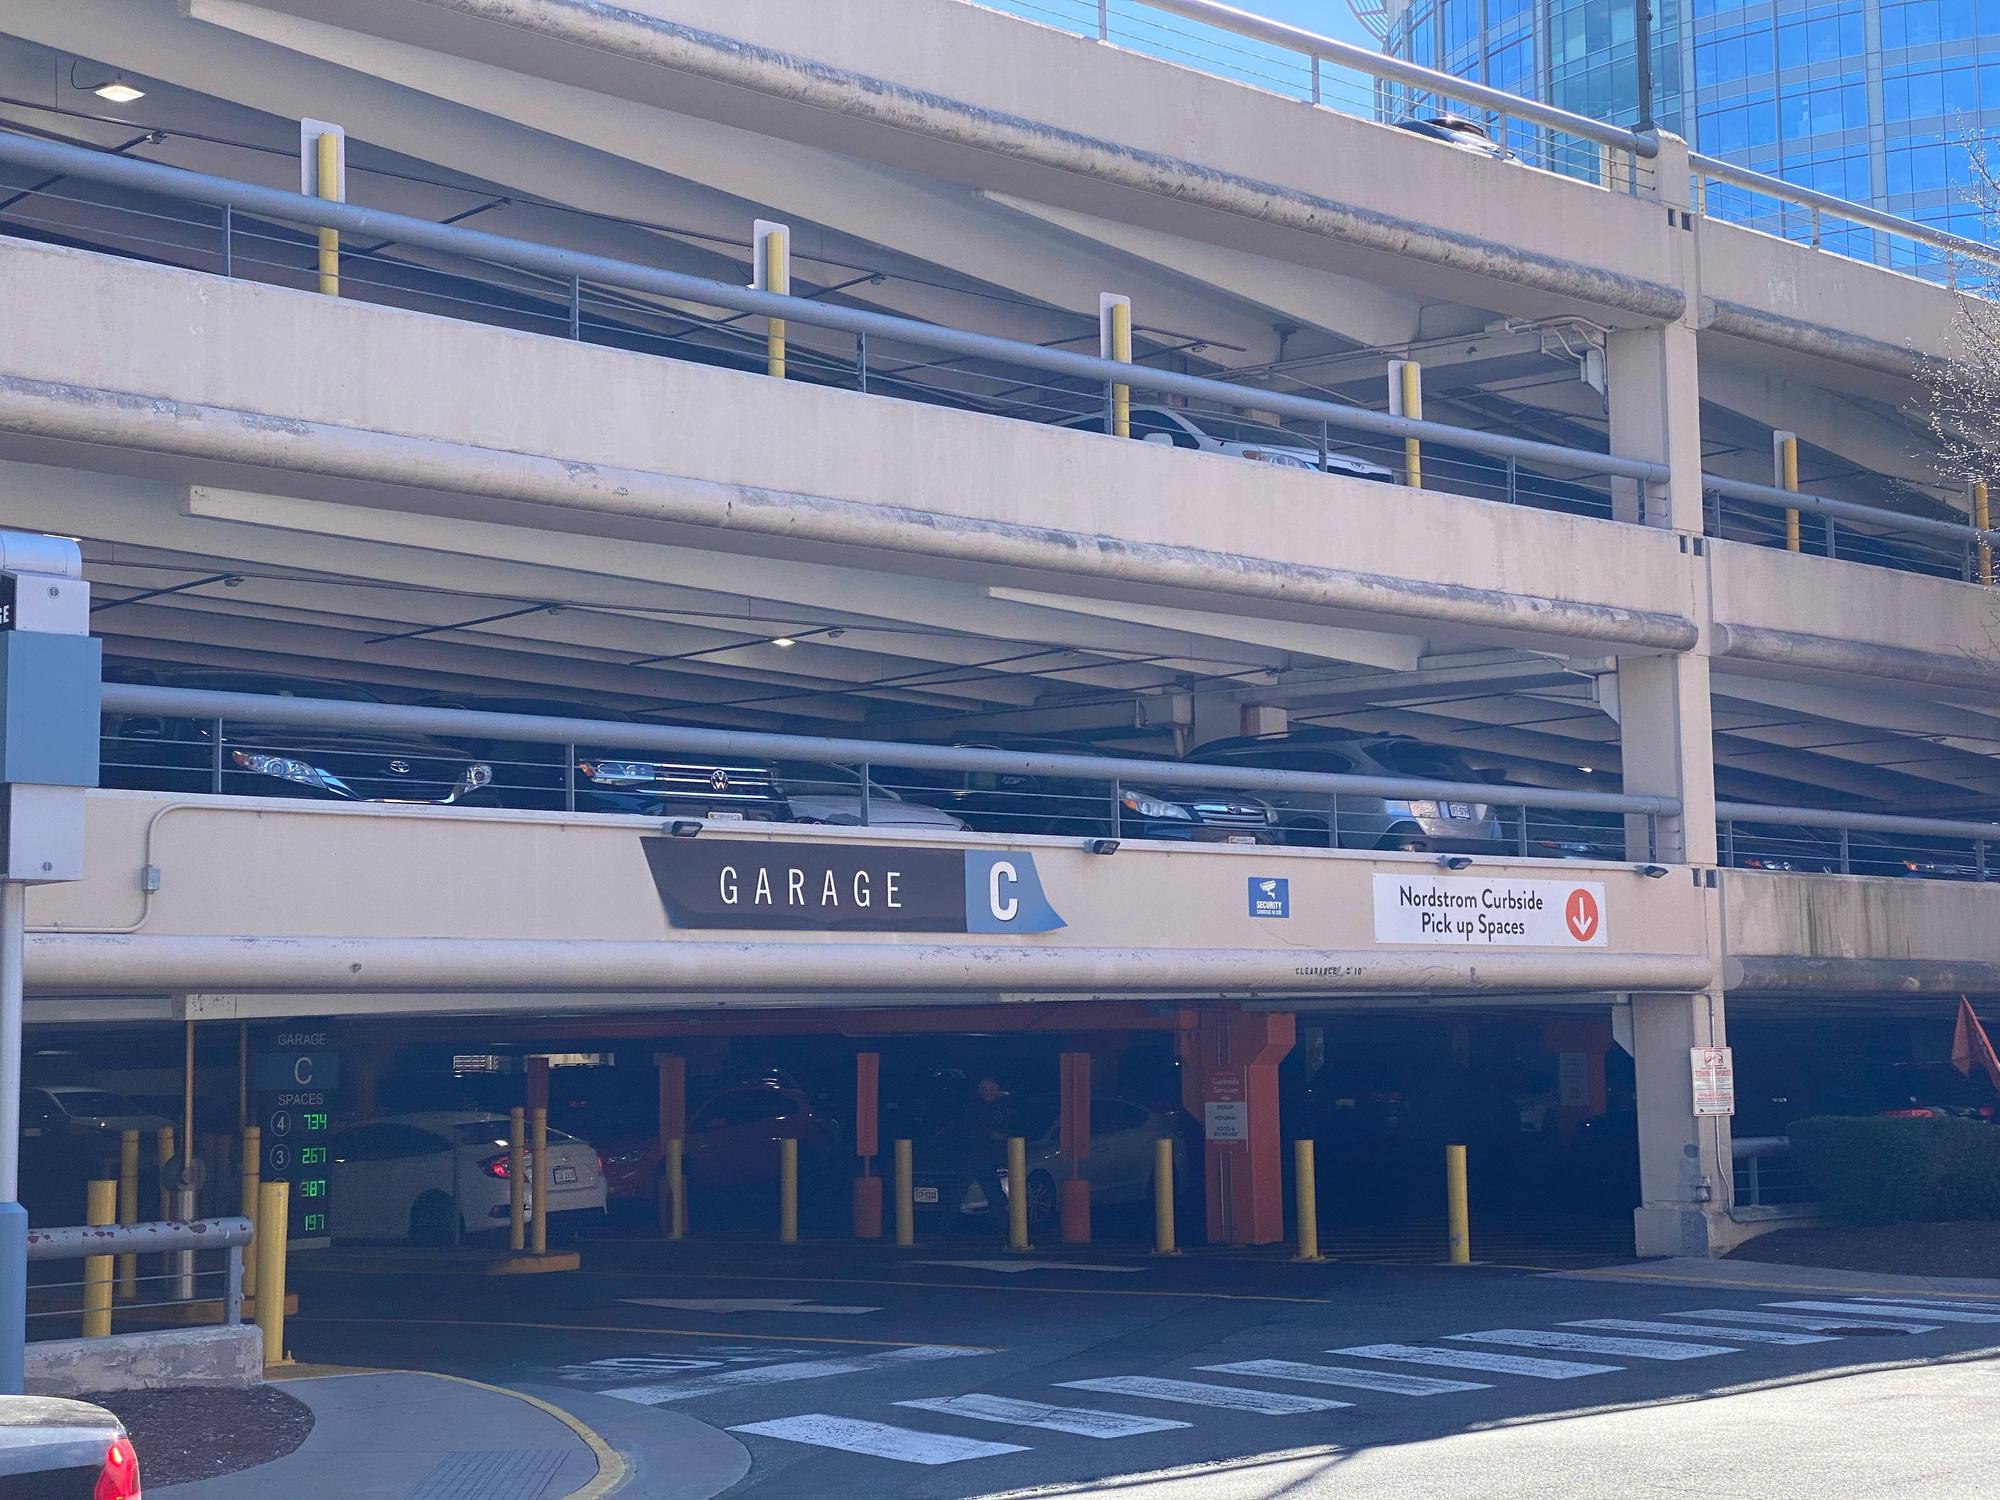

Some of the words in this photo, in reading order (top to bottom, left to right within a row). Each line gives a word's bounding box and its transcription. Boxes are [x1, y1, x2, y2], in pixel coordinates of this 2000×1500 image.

[719, 865, 902, 908] GARAGE
[989, 861, 1019, 921] C
[1399, 885, 1478, 908] Nordstrom
[1481, 888, 1543, 910] Curbside
[1256, 900, 1282, 910] SECURITY
[1421, 912, 1453, 933] Pick
[1456, 919, 1474, 942] up
[1478, 913, 1525, 942] Spaces
[1295, 966, 1338, 975] CLEARANCE
[278, 1033, 327, 1046] GARAGE
[294, 1057, 313, 1085] C
[278, 1093, 324, 1106] SPACES
[276, 1116, 285, 1131] 4
[304, 1113, 327, 1130] 734
[276, 1150, 284, 1165] 3
[302, 1148, 326, 1164] 267
[305, 1214, 325, 1231] 197
